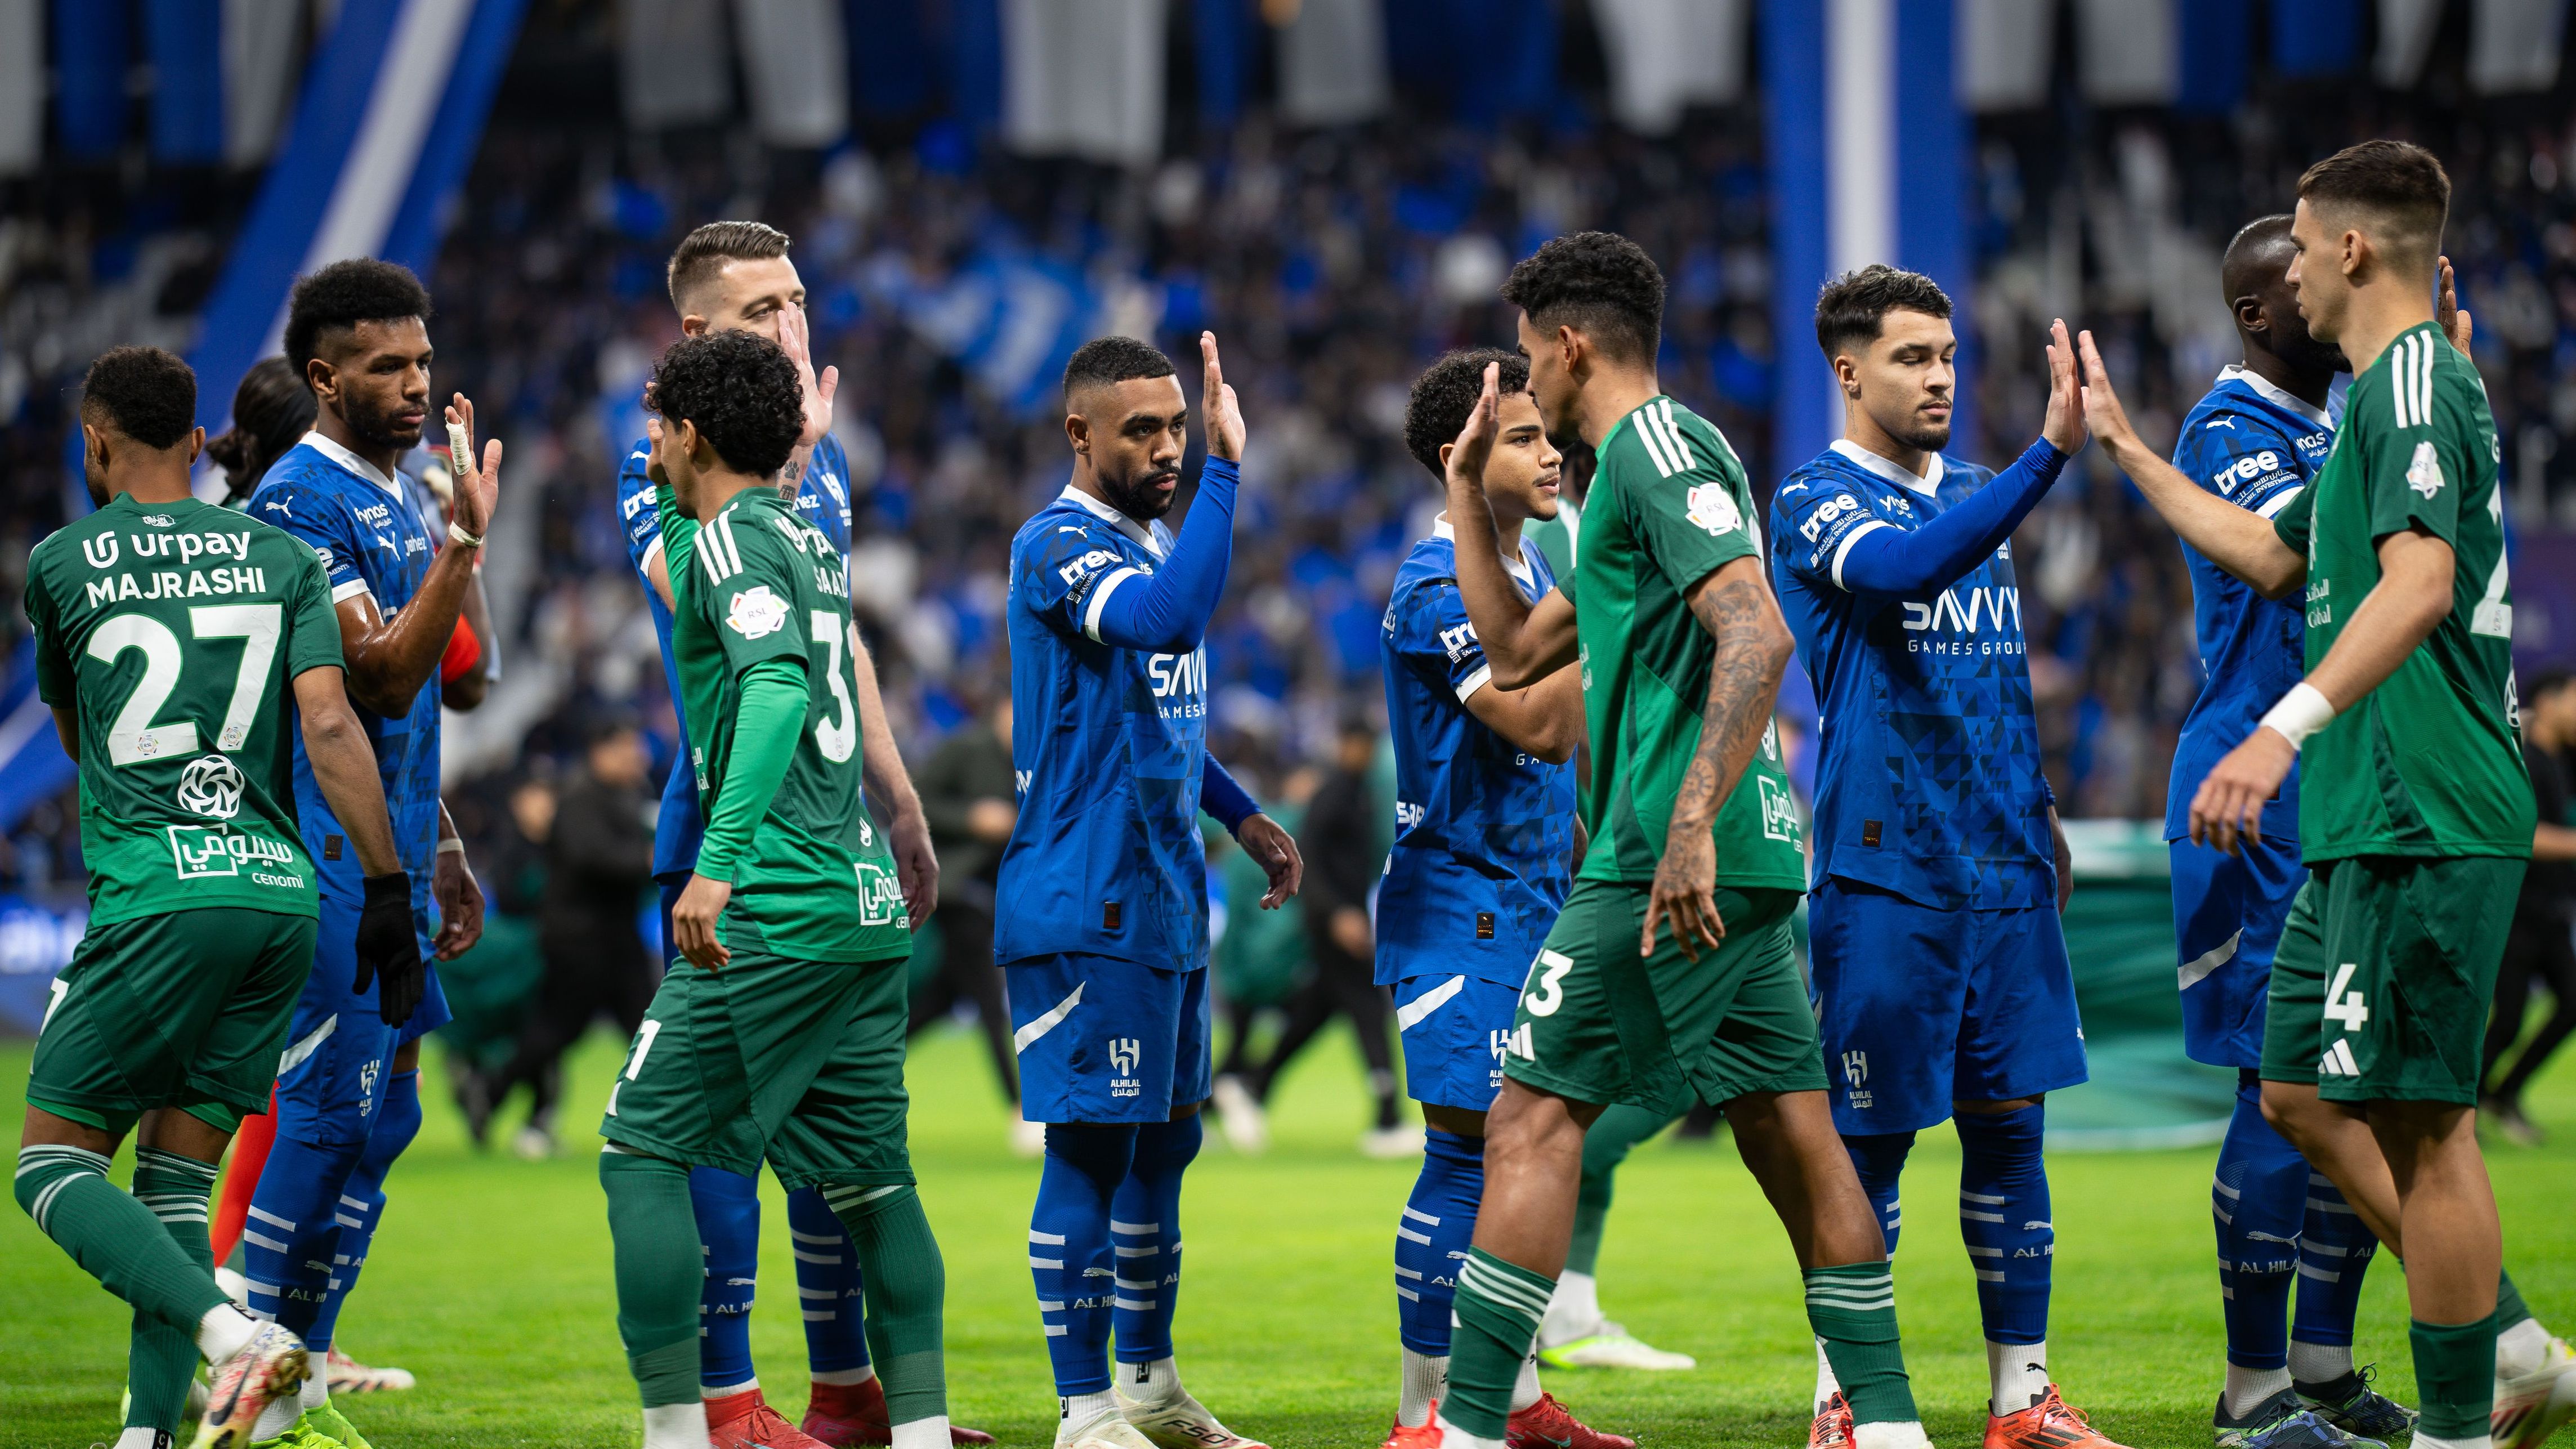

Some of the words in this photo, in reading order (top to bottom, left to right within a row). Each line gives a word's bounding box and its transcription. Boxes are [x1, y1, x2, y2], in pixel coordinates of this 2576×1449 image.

[2213, 451, 2279, 495] tree
[2257, 473, 2298, 494] INVESTMENTS
[1706, 503, 1725, 513] RSL
[1799, 494, 1858, 543] tree
[133, 531, 251, 562] urpay
[1058, 550, 1123, 585] tree
[86, 567, 266, 608] MAJRASHI
[748, 608, 768, 619] RSL
[1908, 639, 1973, 655] GAMES
[87, 603, 283, 767] 27
[1111, 1079, 1141, 1088] ALHILAL
[1112, 1088, 1139, 1097] الهلال
[1849, 1090, 1873, 1099] ALHILAL
[1852, 1099, 1873, 1108] الهلال
[2014, 1247, 2039, 1259] AL
[2239, 1261, 2263, 1273] AL
[1431, 1276, 1457, 1287] AL
[288, 1288, 310, 1301] AL
[715, 1304, 738, 1314] AL
[1074, 1298, 1097, 1309] AL
[1162, 1419, 1229, 1444] F50
